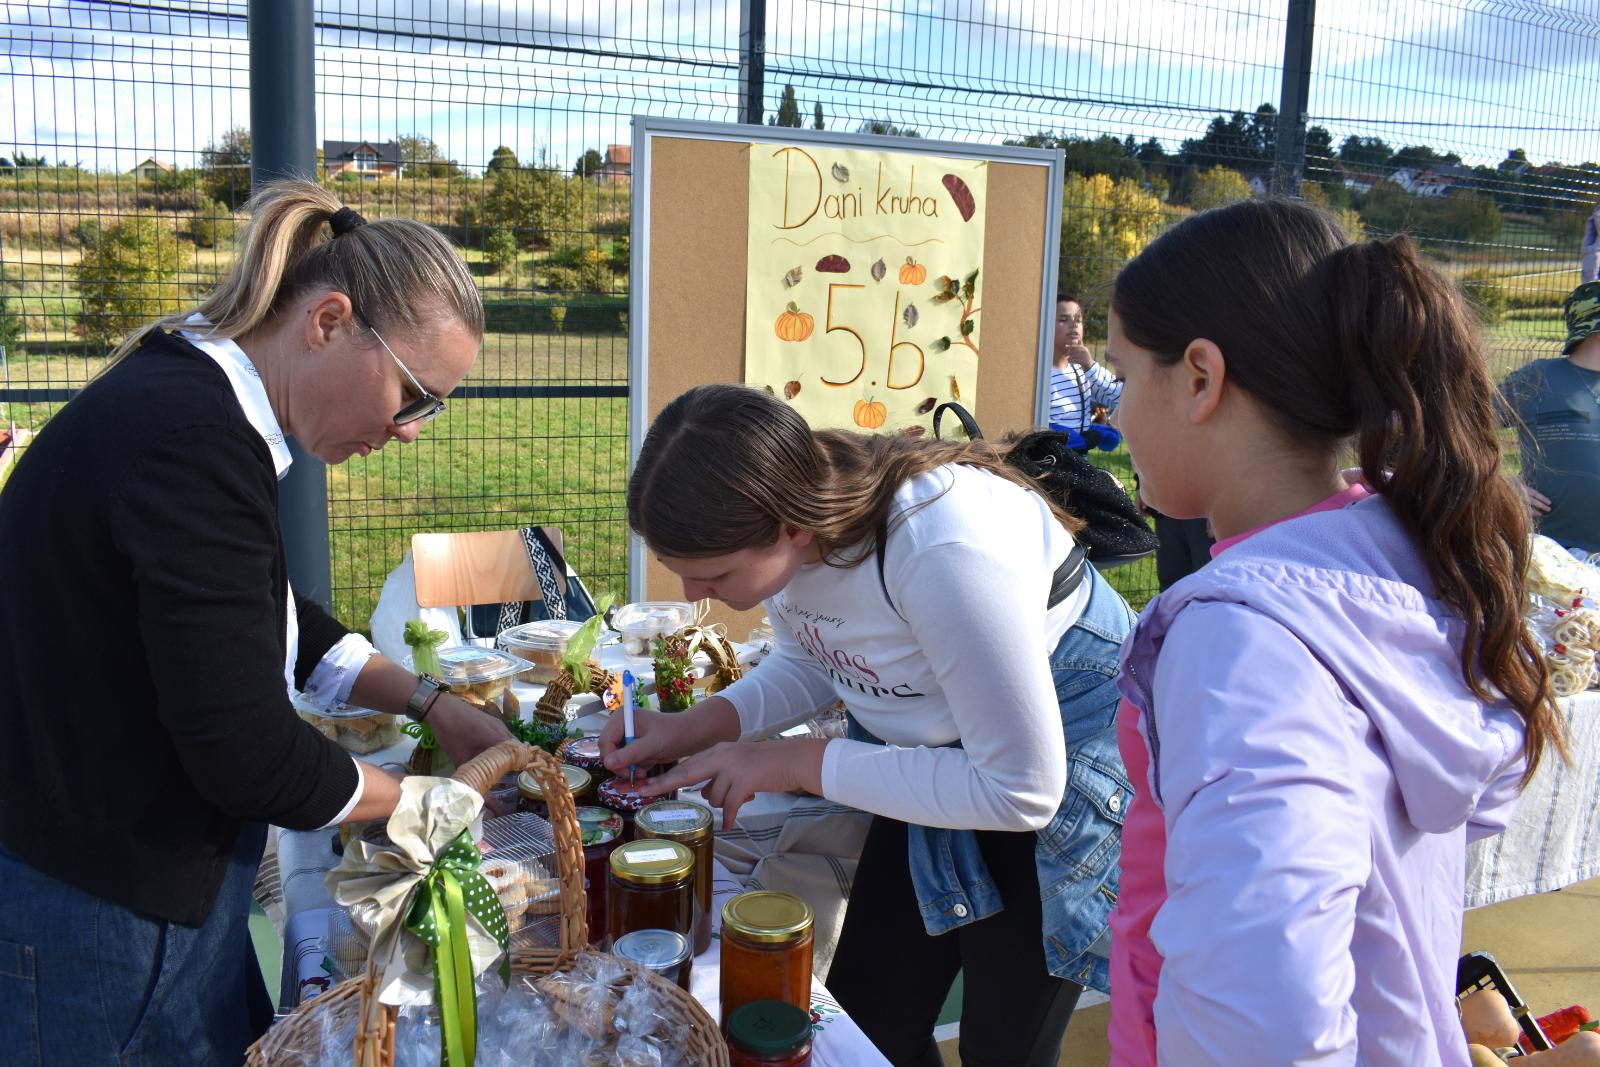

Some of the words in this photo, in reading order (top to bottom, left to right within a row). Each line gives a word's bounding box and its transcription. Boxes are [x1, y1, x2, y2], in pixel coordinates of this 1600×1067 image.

[772, 146, 863, 230] Dani
[875, 160, 940, 219] kruha
[820, 282, 925, 390] 5.b
